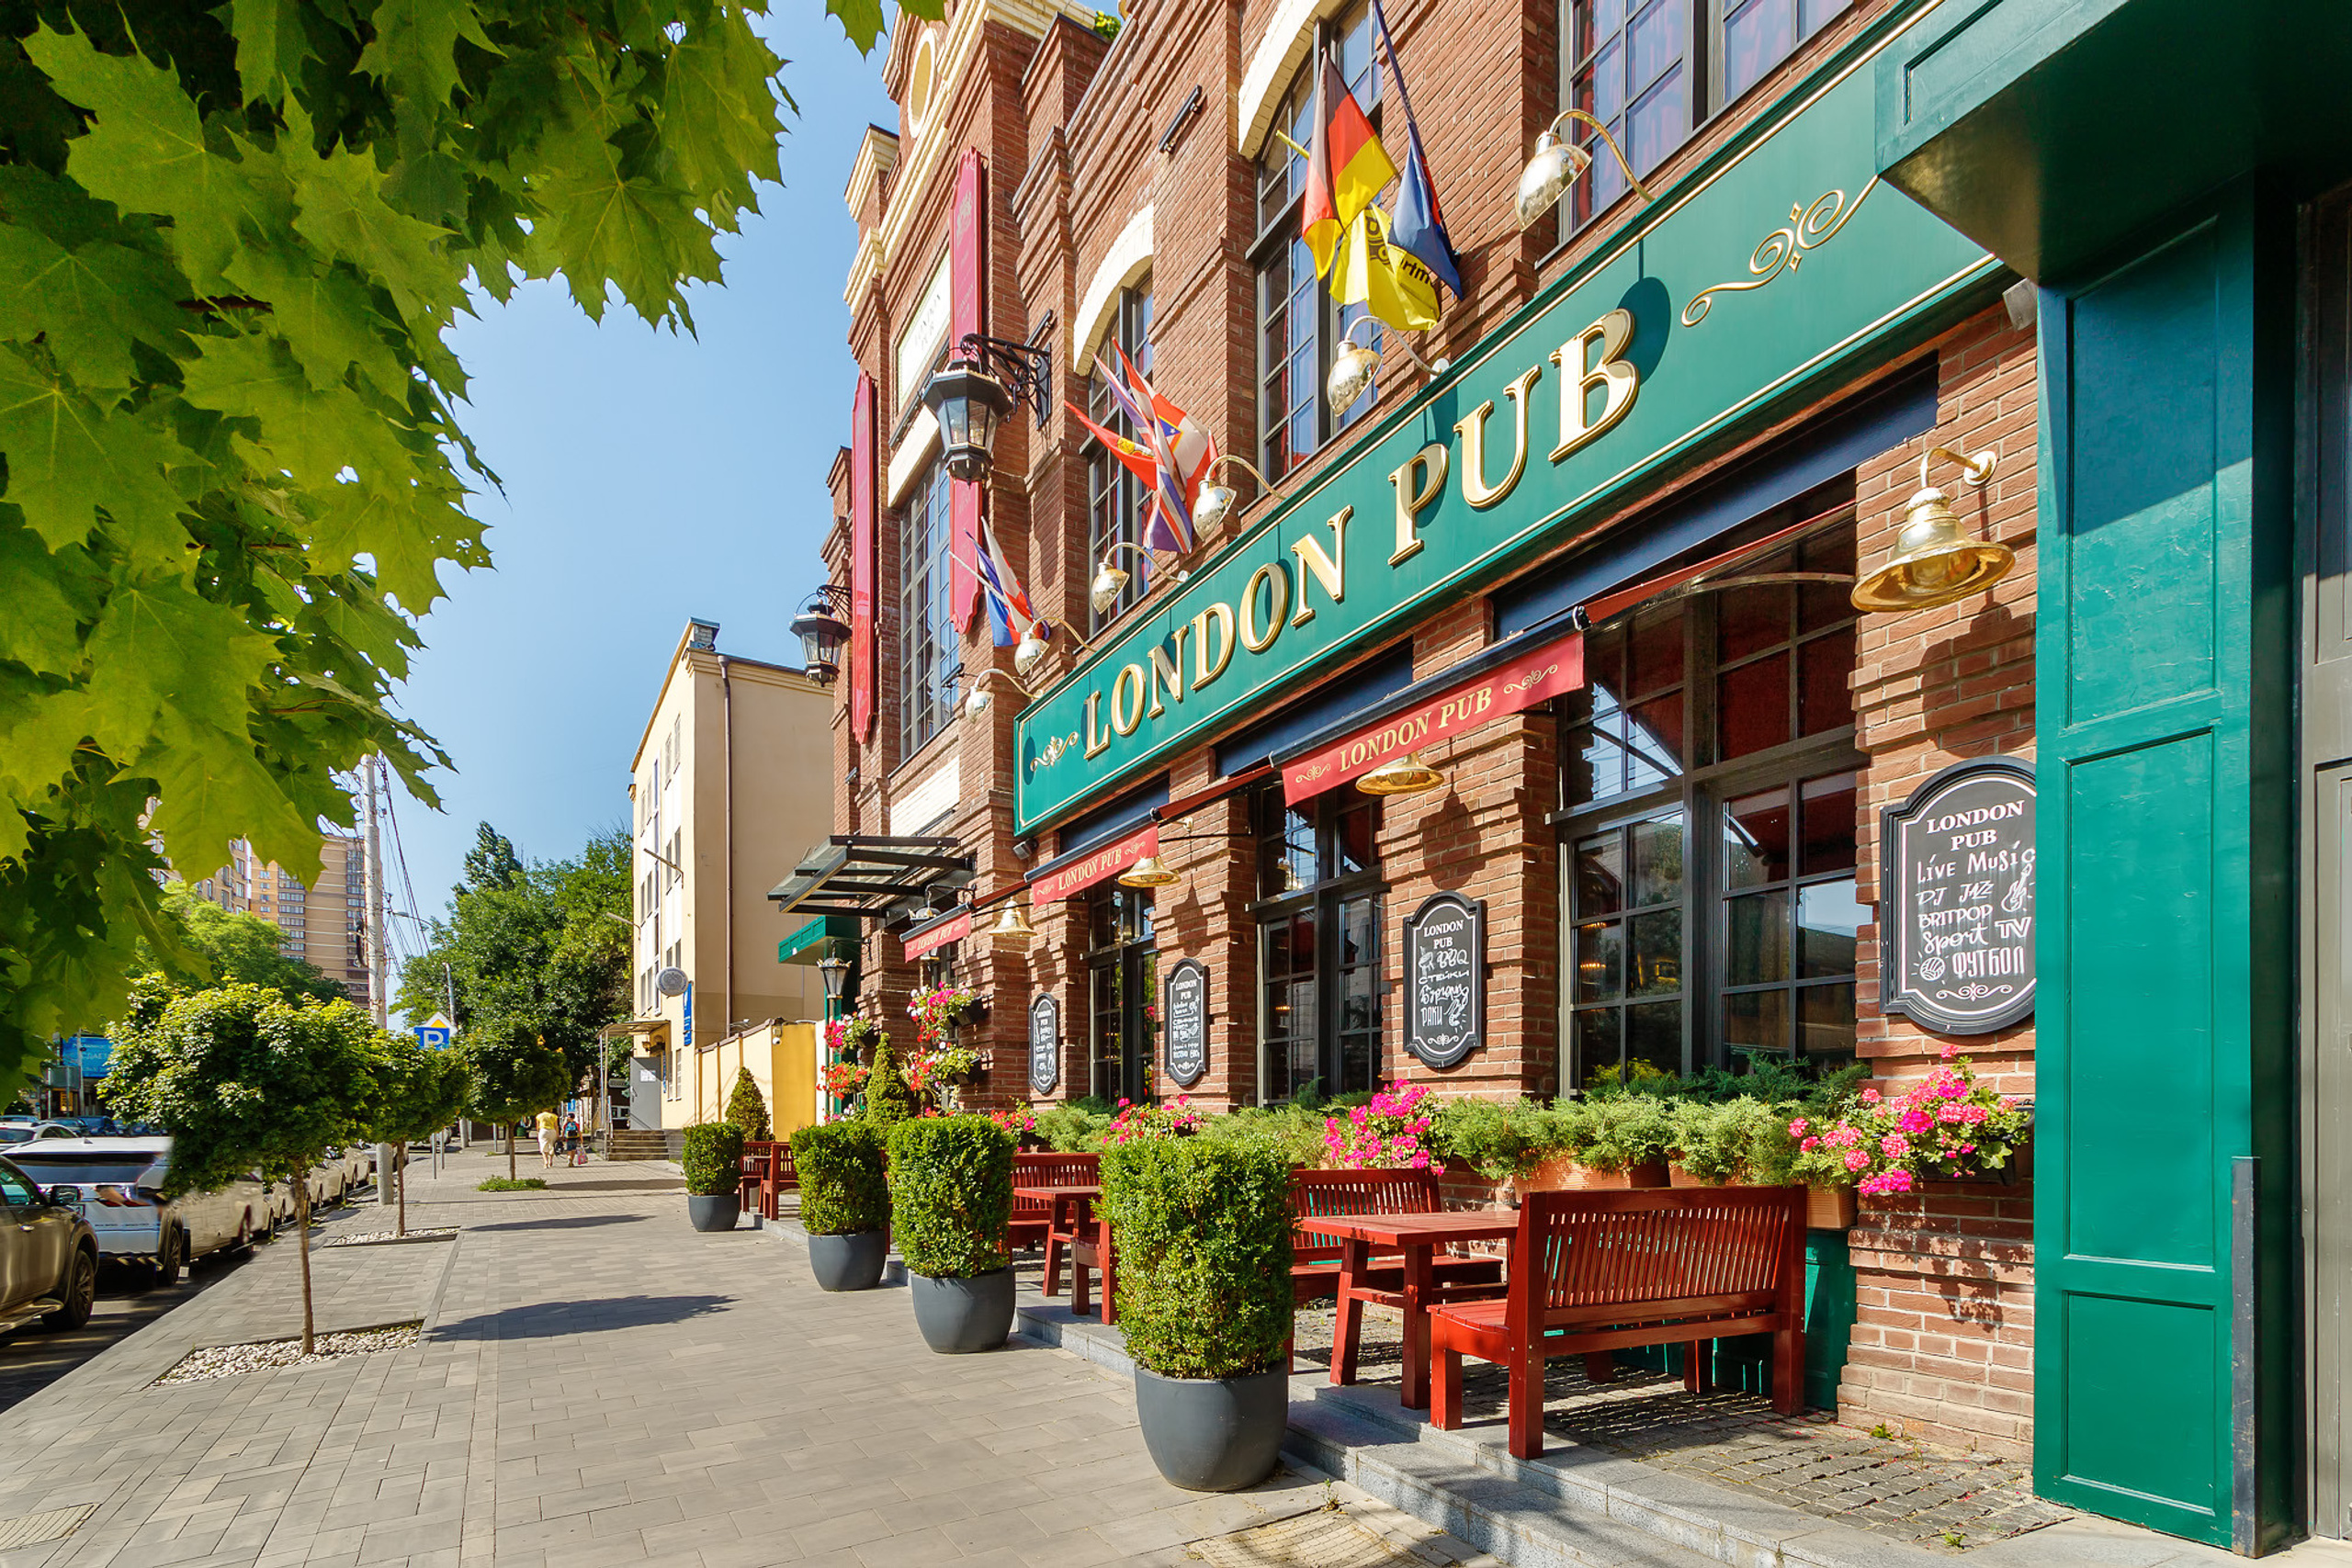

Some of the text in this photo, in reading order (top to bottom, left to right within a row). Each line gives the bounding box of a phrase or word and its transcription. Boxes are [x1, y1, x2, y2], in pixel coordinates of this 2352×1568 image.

[1083, 308, 1640, 761] LONDON PUB
[1339, 686, 1492, 772] LONDON PUB
[1927, 800, 2025, 834] LONDON
[1951, 829, 1997, 852] PUB
[1058, 848, 1122, 891] LONDON PUB
[1915, 880, 1995, 907] DJ JAZZ
[1423, 919, 1464, 938] LONDON
[1917, 904, 1994, 930] BRITPOP
[1433, 936, 1453, 950] PUB
[1922, 917, 2032, 956] Sport TV
[1436, 948, 1469, 969] BBQ
[1951, 945, 2026, 979] ФУТБОЛ
[1420, 1006, 1442, 1027] РАКИ
[424, 1030, 444, 1050] P
